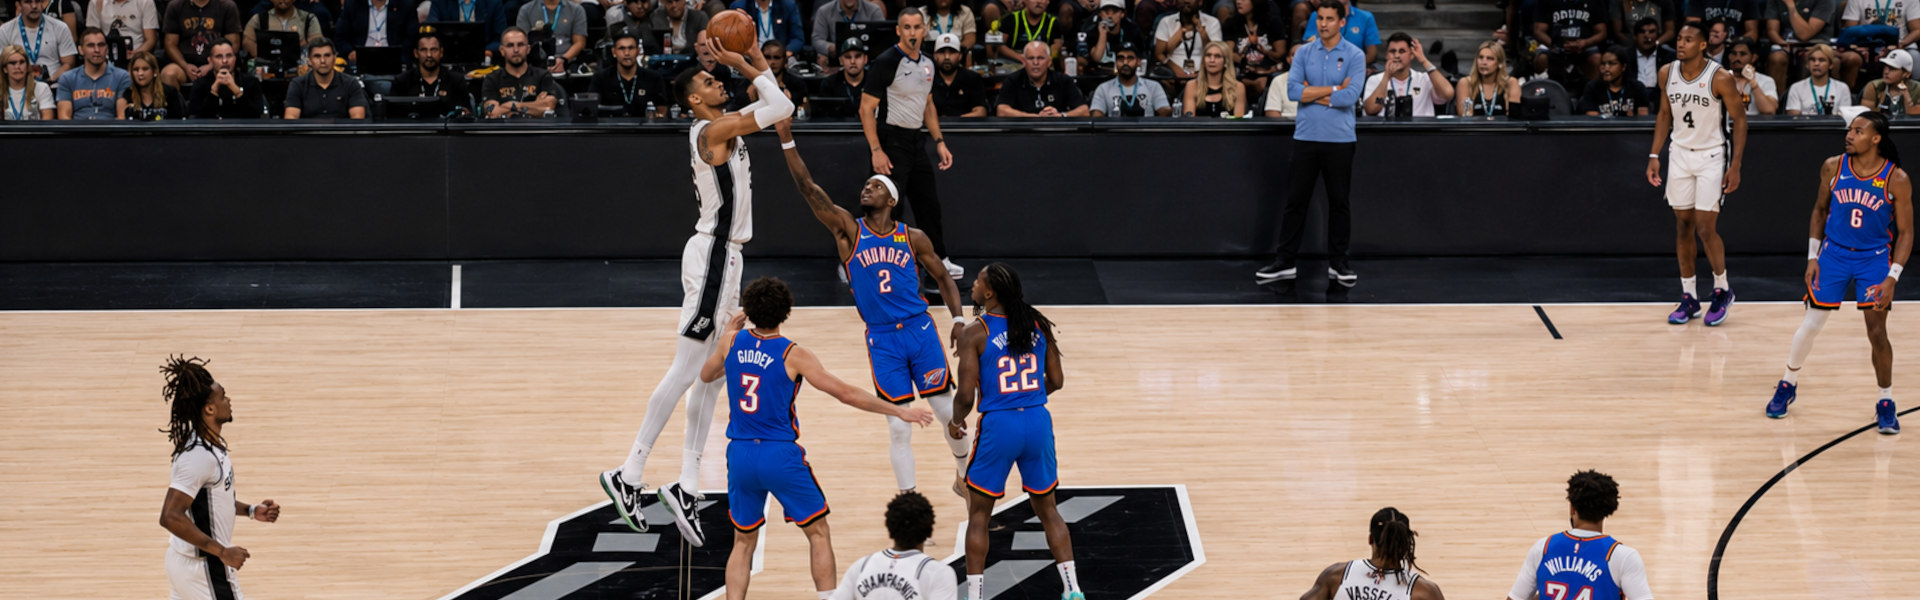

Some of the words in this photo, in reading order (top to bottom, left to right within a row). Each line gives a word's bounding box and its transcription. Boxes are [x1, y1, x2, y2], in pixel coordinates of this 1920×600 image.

[1669, 93, 1710, 108] SPURS
[1682, 110, 1695, 129] 4
[1850, 208, 1864, 229] 6
[855, 246, 911, 269] THUNDER
[878, 269, 893, 294] 2
[737, 349, 775, 371] GIDDEY
[997, 353, 1040, 394] 22
[739, 372, 761, 414] 3
[1544, 556, 1603, 582] WILLIAMS
